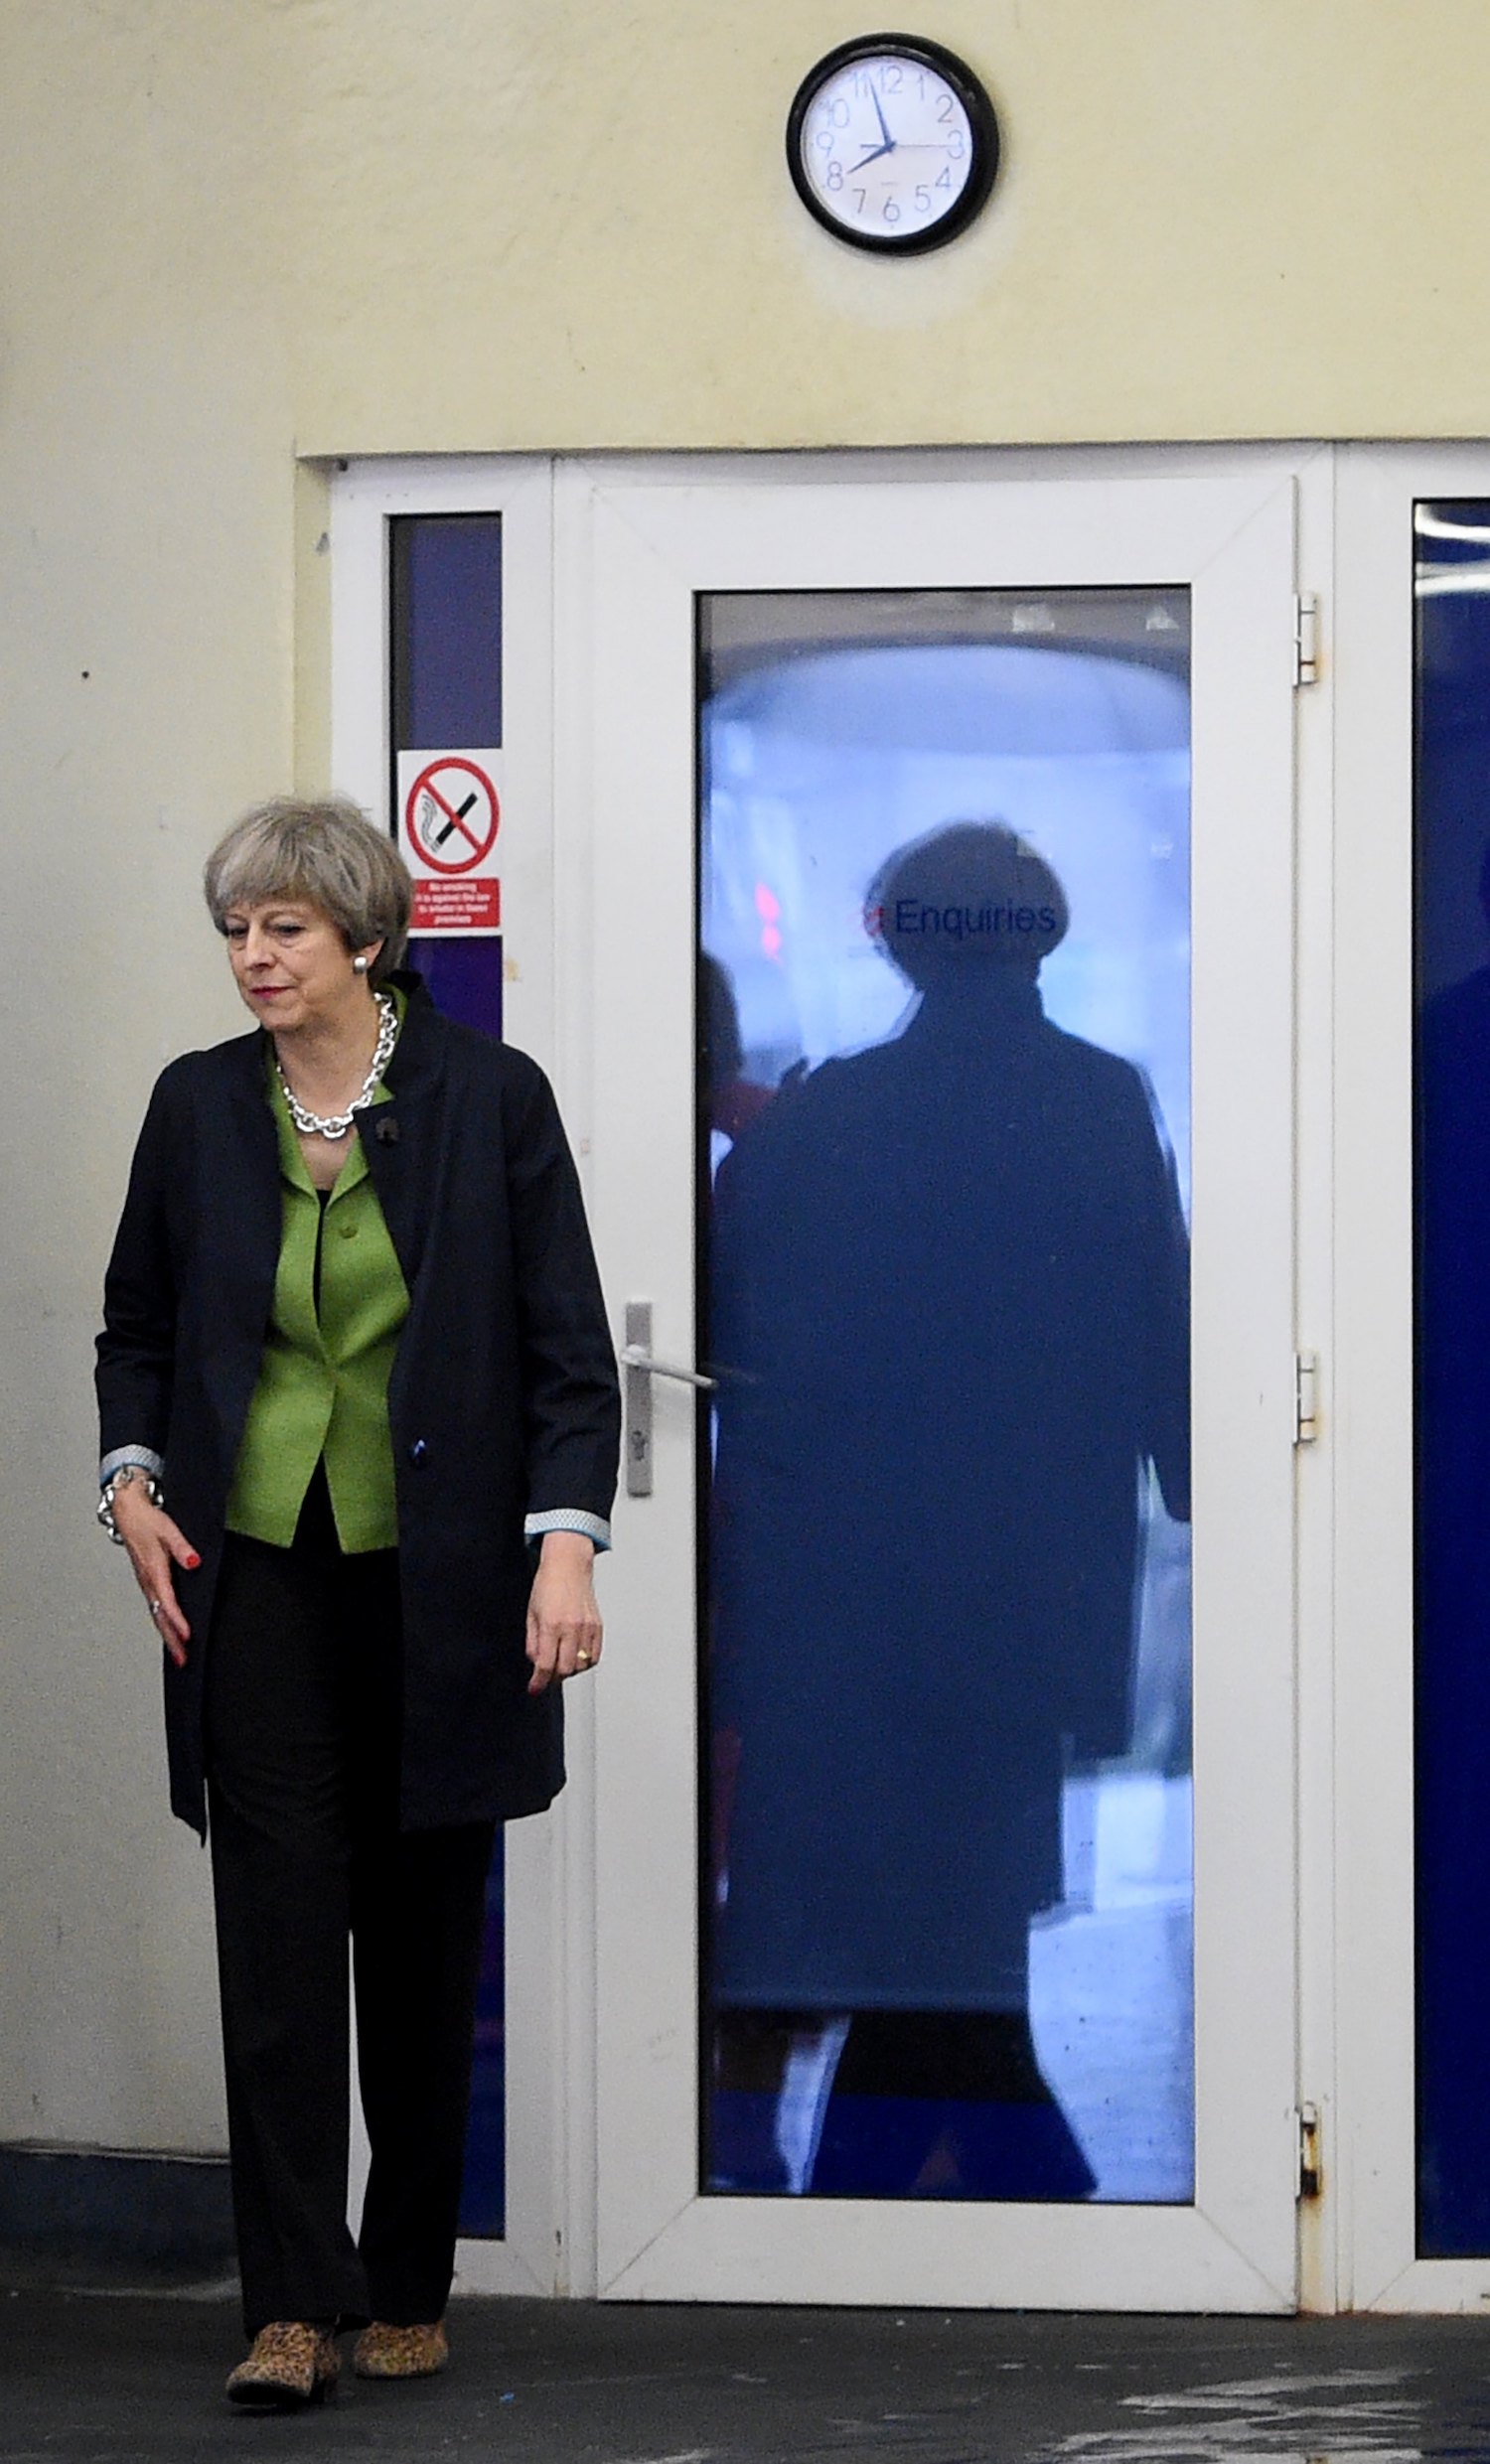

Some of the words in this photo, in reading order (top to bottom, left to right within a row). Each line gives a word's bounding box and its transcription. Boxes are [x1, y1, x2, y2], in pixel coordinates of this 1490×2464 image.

[880, 65, 903, 94] 12
[825, 98, 850, 128] 10
[936, 93, 954, 123] 2
[816, 131, 834, 158] 9
[947, 129, 965, 159] 3
[825, 161, 843, 191] 8
[935, 165, 952, 190] 4
[851, 188, 866, 214] 7
[883, 196, 900, 221] 6
[914, 185, 931, 212] 5
[896, 898, 1057, 940] Enquiries
